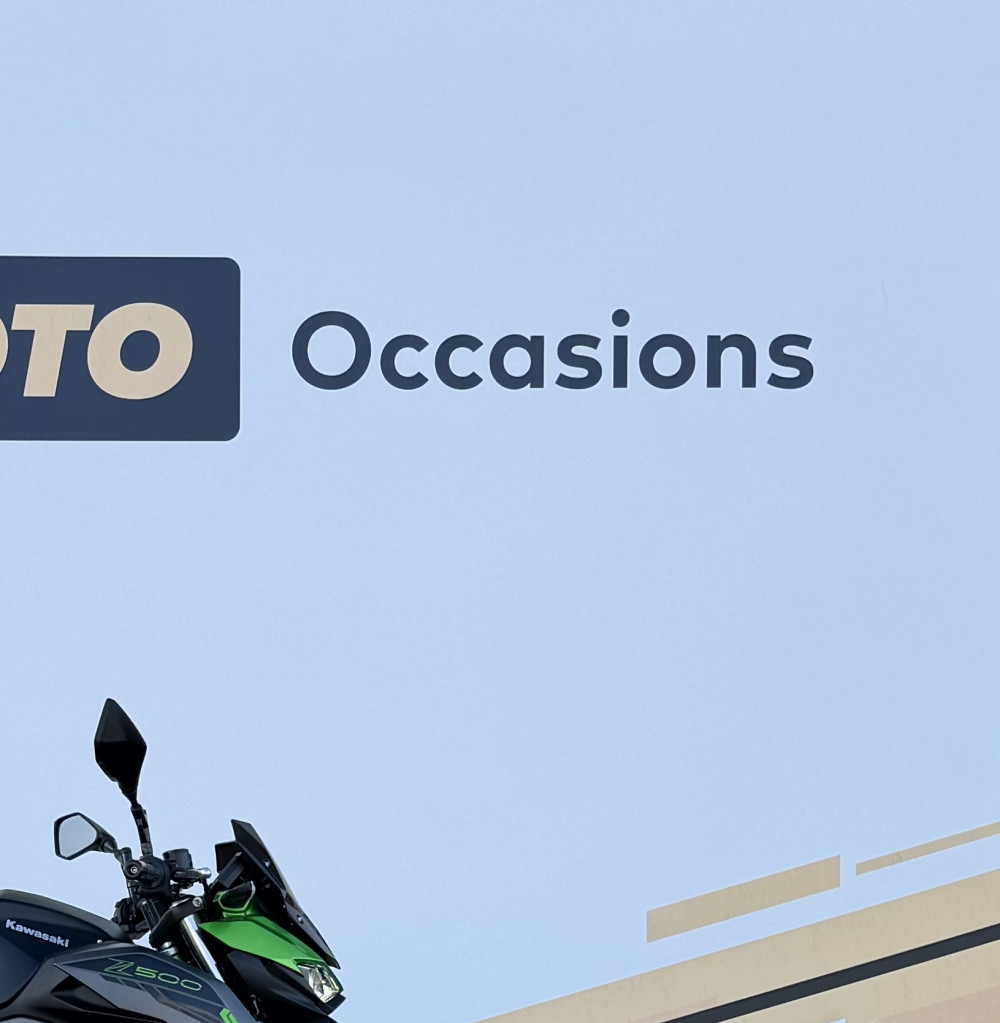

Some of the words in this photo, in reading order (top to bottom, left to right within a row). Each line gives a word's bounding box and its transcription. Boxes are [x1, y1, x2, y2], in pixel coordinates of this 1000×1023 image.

[292, 309, 813, 390] Occasions
[5, 919, 69, 948] Kawasaki
[103, 958, 202, 991] Z500
